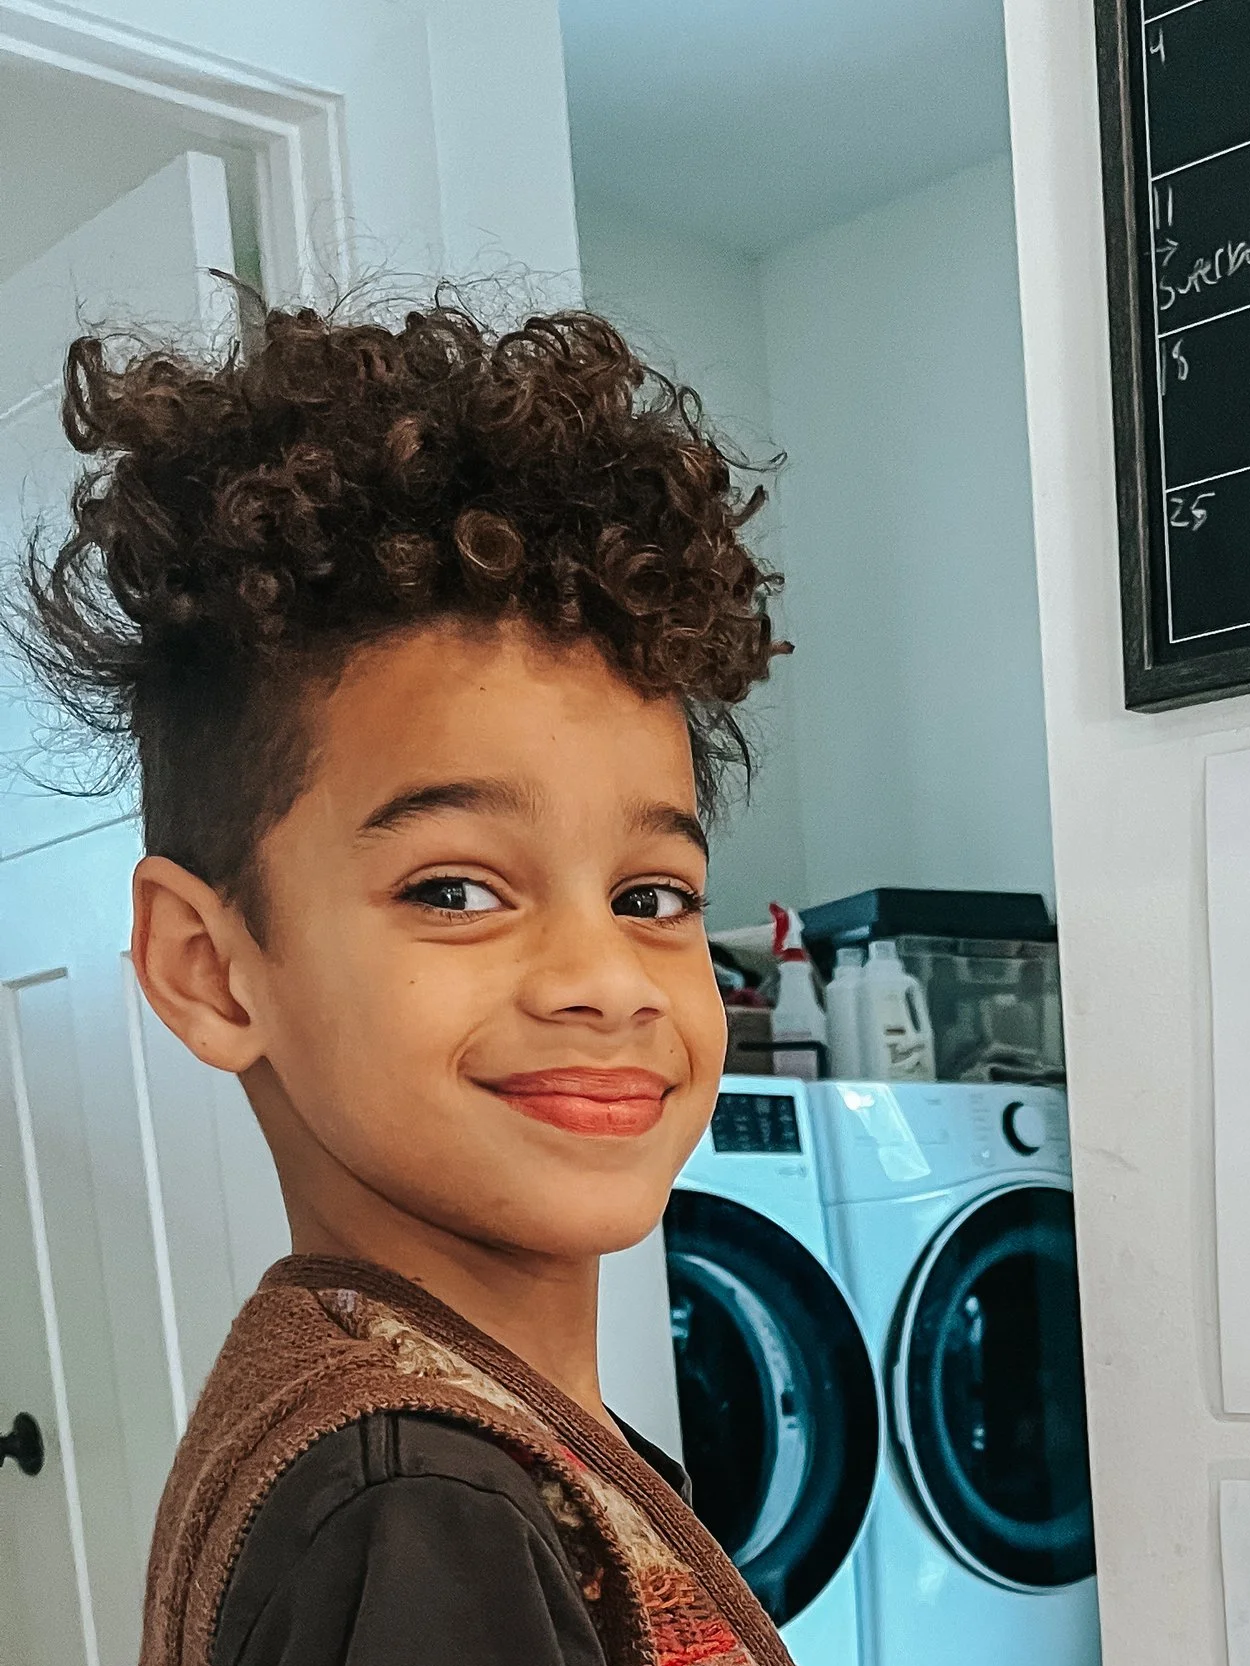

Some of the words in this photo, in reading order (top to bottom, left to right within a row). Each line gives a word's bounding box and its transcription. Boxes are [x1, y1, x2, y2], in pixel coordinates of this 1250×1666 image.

[1149, 27, 1166, 66] 4
[1153, 184, 1174, 231] 11
[1161, 336, 1190, 397] 18
[1170, 491, 1216, 533] 25
